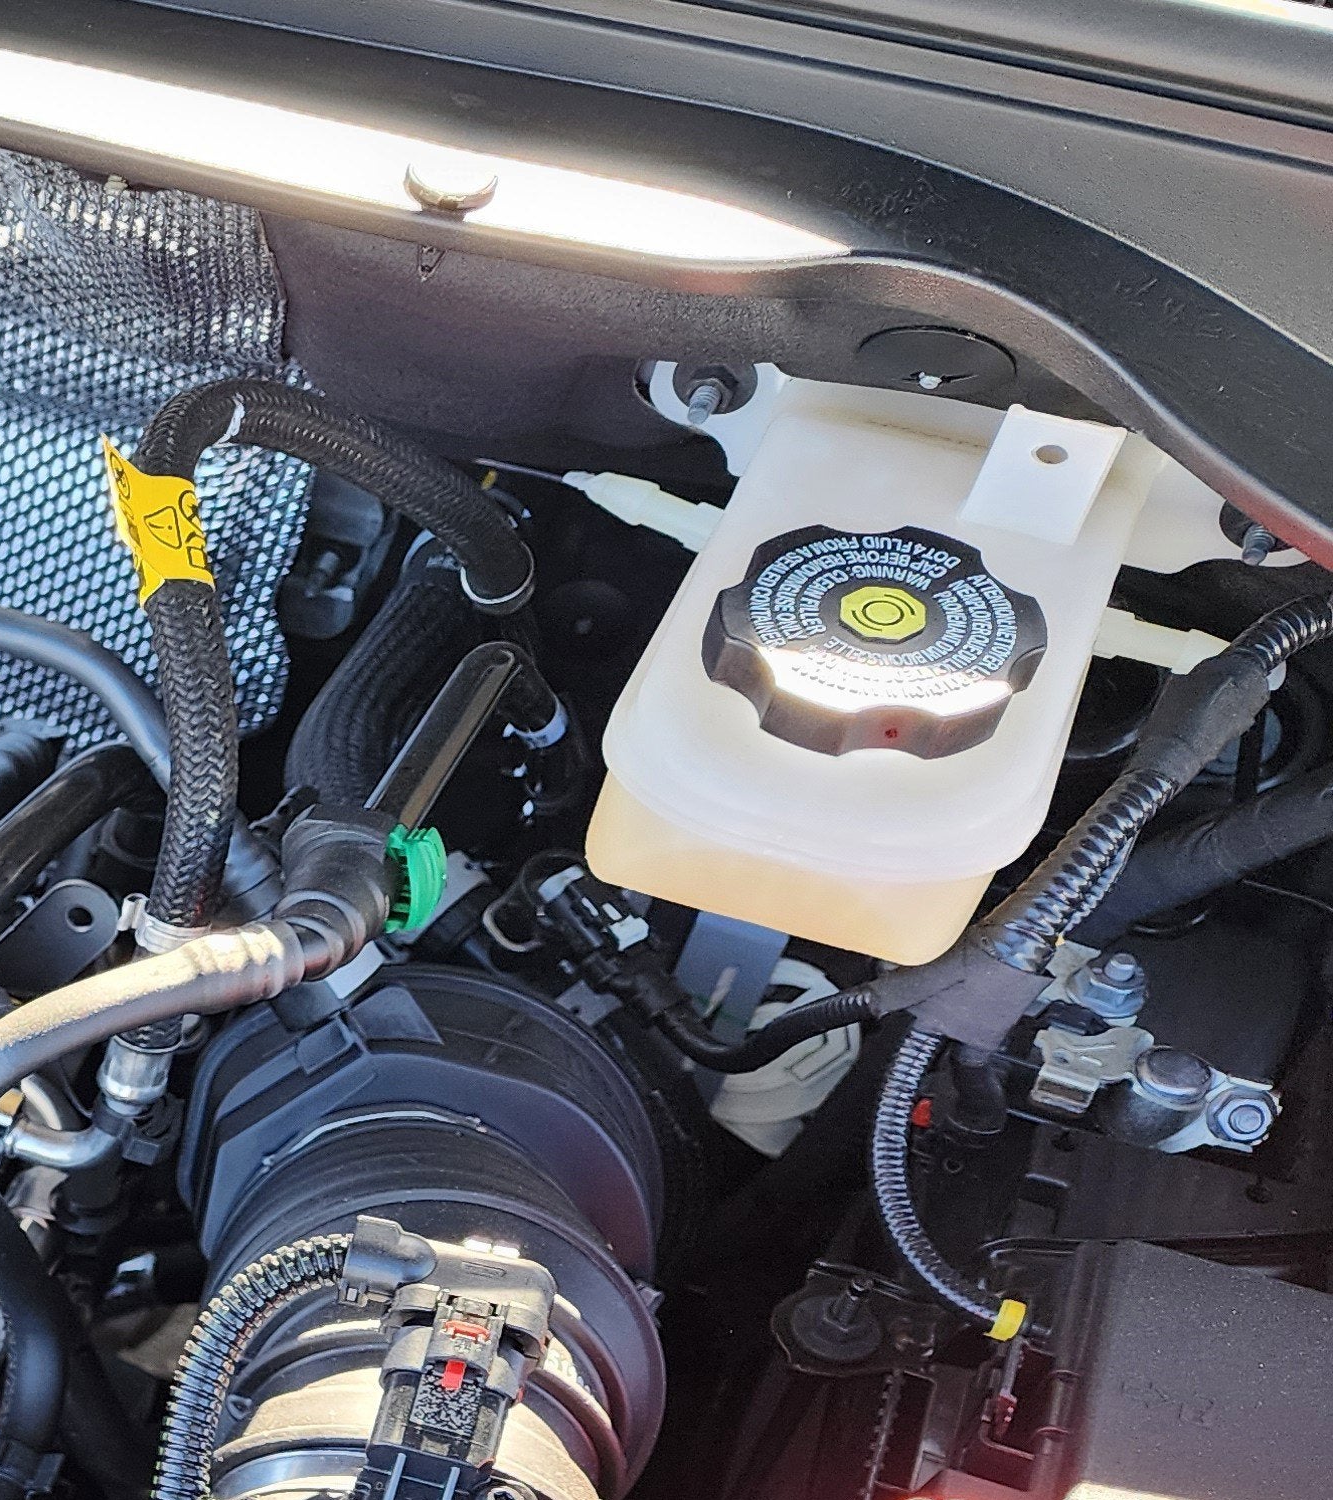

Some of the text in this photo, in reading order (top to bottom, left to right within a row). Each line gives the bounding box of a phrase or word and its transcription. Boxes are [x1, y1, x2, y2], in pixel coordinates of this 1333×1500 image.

[842, 551, 912, 566] BEFORE
[908, 557, 948, 579] CAP
[748, 535, 962, 648] DOT 4 FLUID FROM A SEALED CONTAINER
[775, 589, 798, 611] USE
[799, 565, 932, 635] WARNING: CLEAN FILLER
[775, 612, 809, 641] ONLY
[933, 589, 967, 646] PROVENANT
